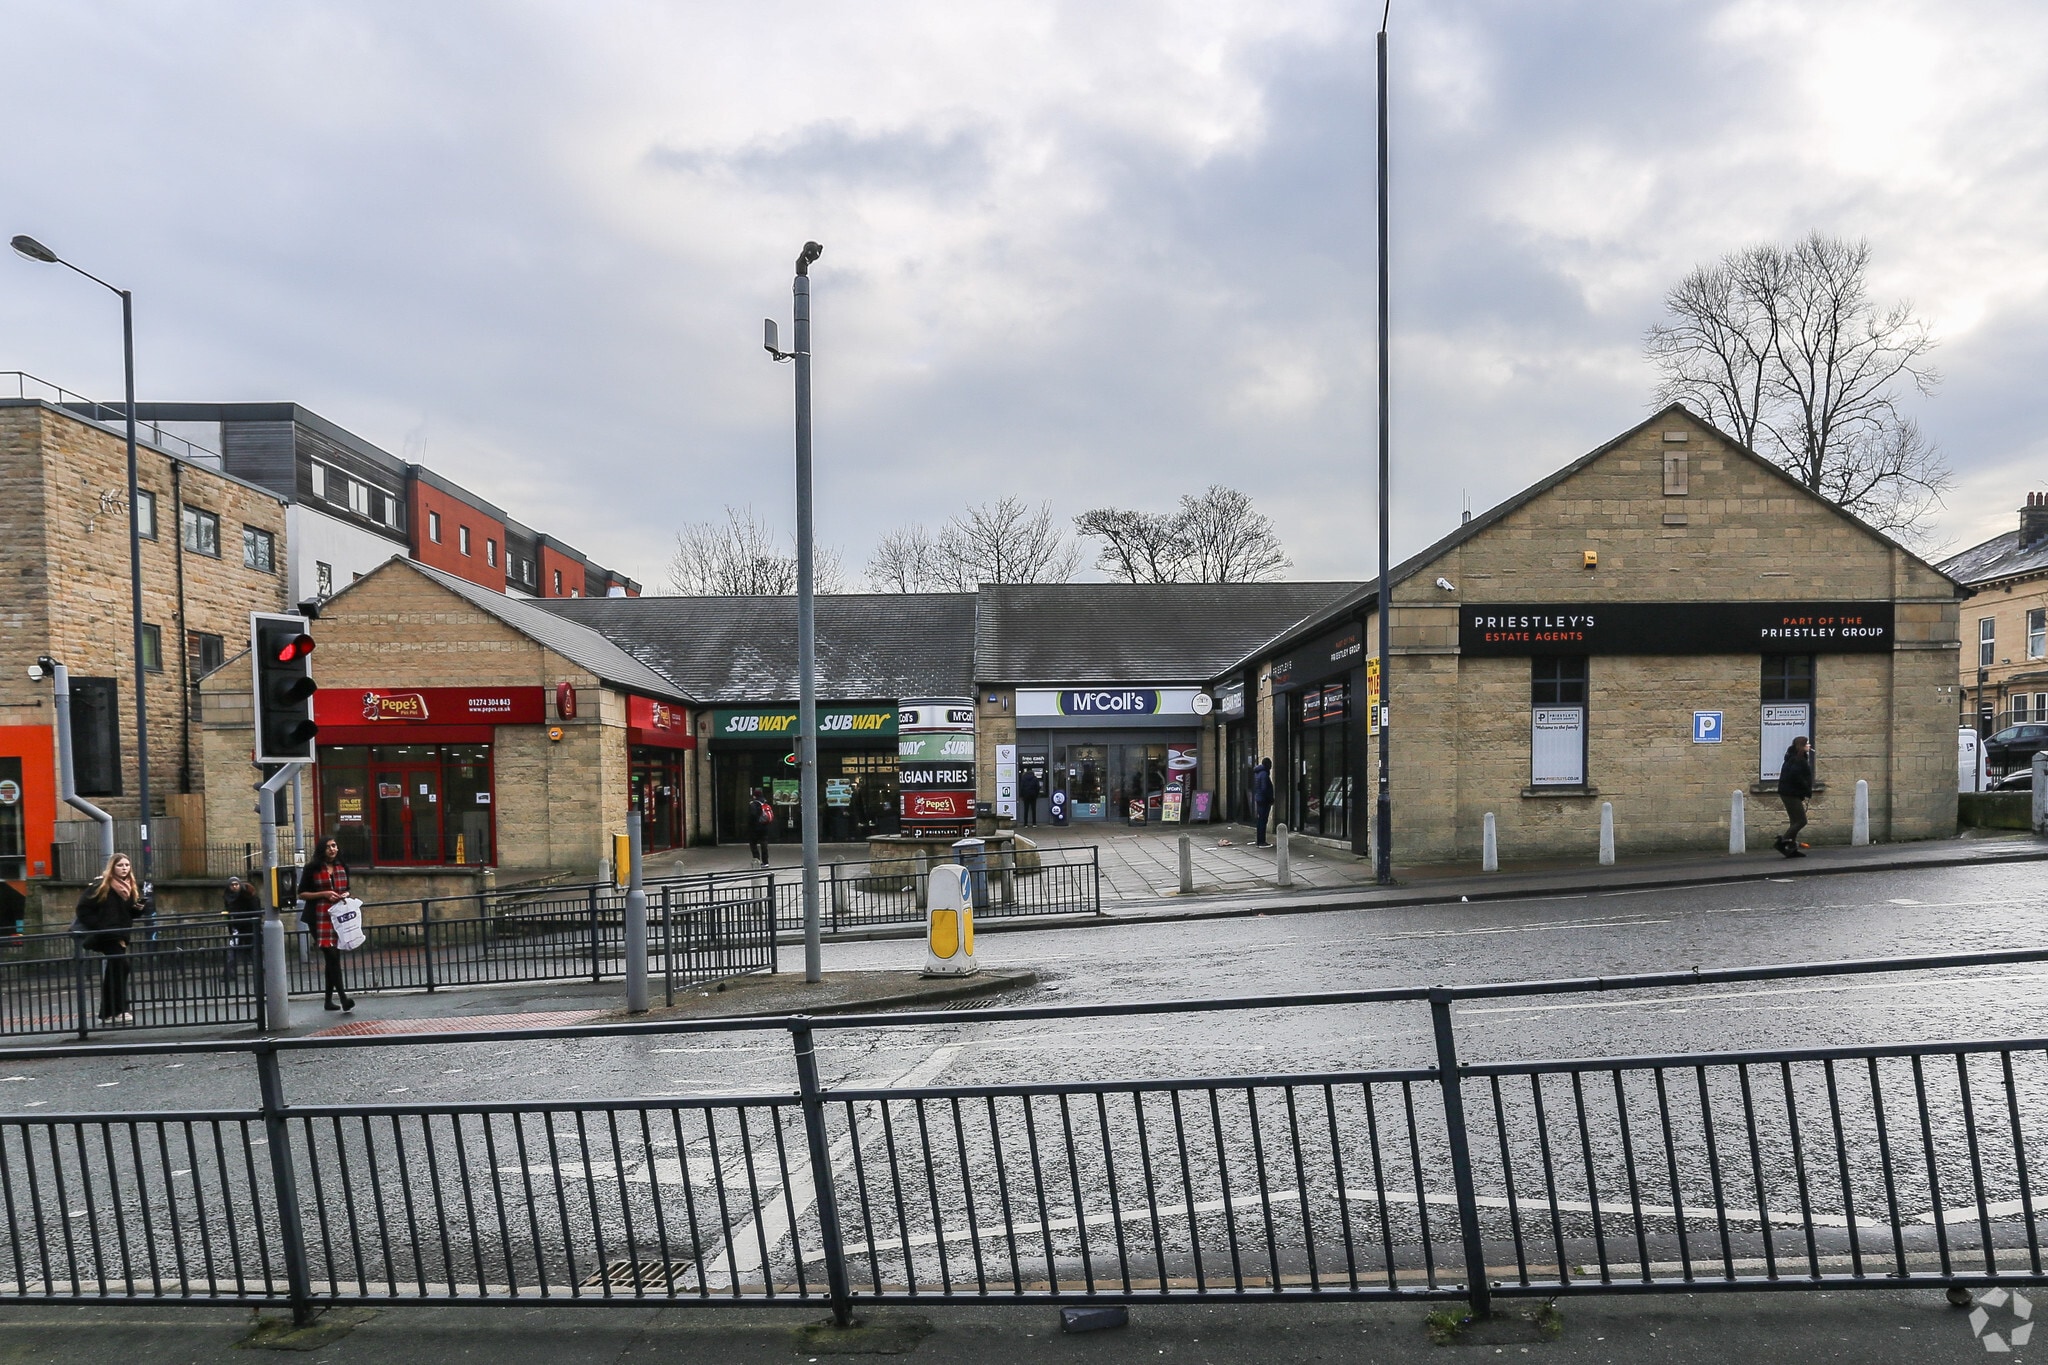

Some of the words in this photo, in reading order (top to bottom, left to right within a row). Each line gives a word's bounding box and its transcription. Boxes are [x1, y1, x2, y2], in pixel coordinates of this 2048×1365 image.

[1475, 615, 1595, 628] PRIESTLEY'S
[1783, 617, 1813, 625] PART
[1818, 617, 1835, 625] OF
[1839, 616, 1863, 624] THE
[1485, 632, 1530, 642] ESTATE
[1535, 631, 1583, 641] AGENTS
[1761, 628, 1836, 638] PRIESTLEY
[1841, 627, 1883, 637] GROUP
[381, 697, 417, 713] Pepe's
[1073, 692, 1144, 711] McColl's
[725, 714, 797, 732] SUBWAY
[819, 713, 891, 731] SUBWAY
[936, 770, 968, 783] FRIES
[925, 800, 950, 811] Pepe's
